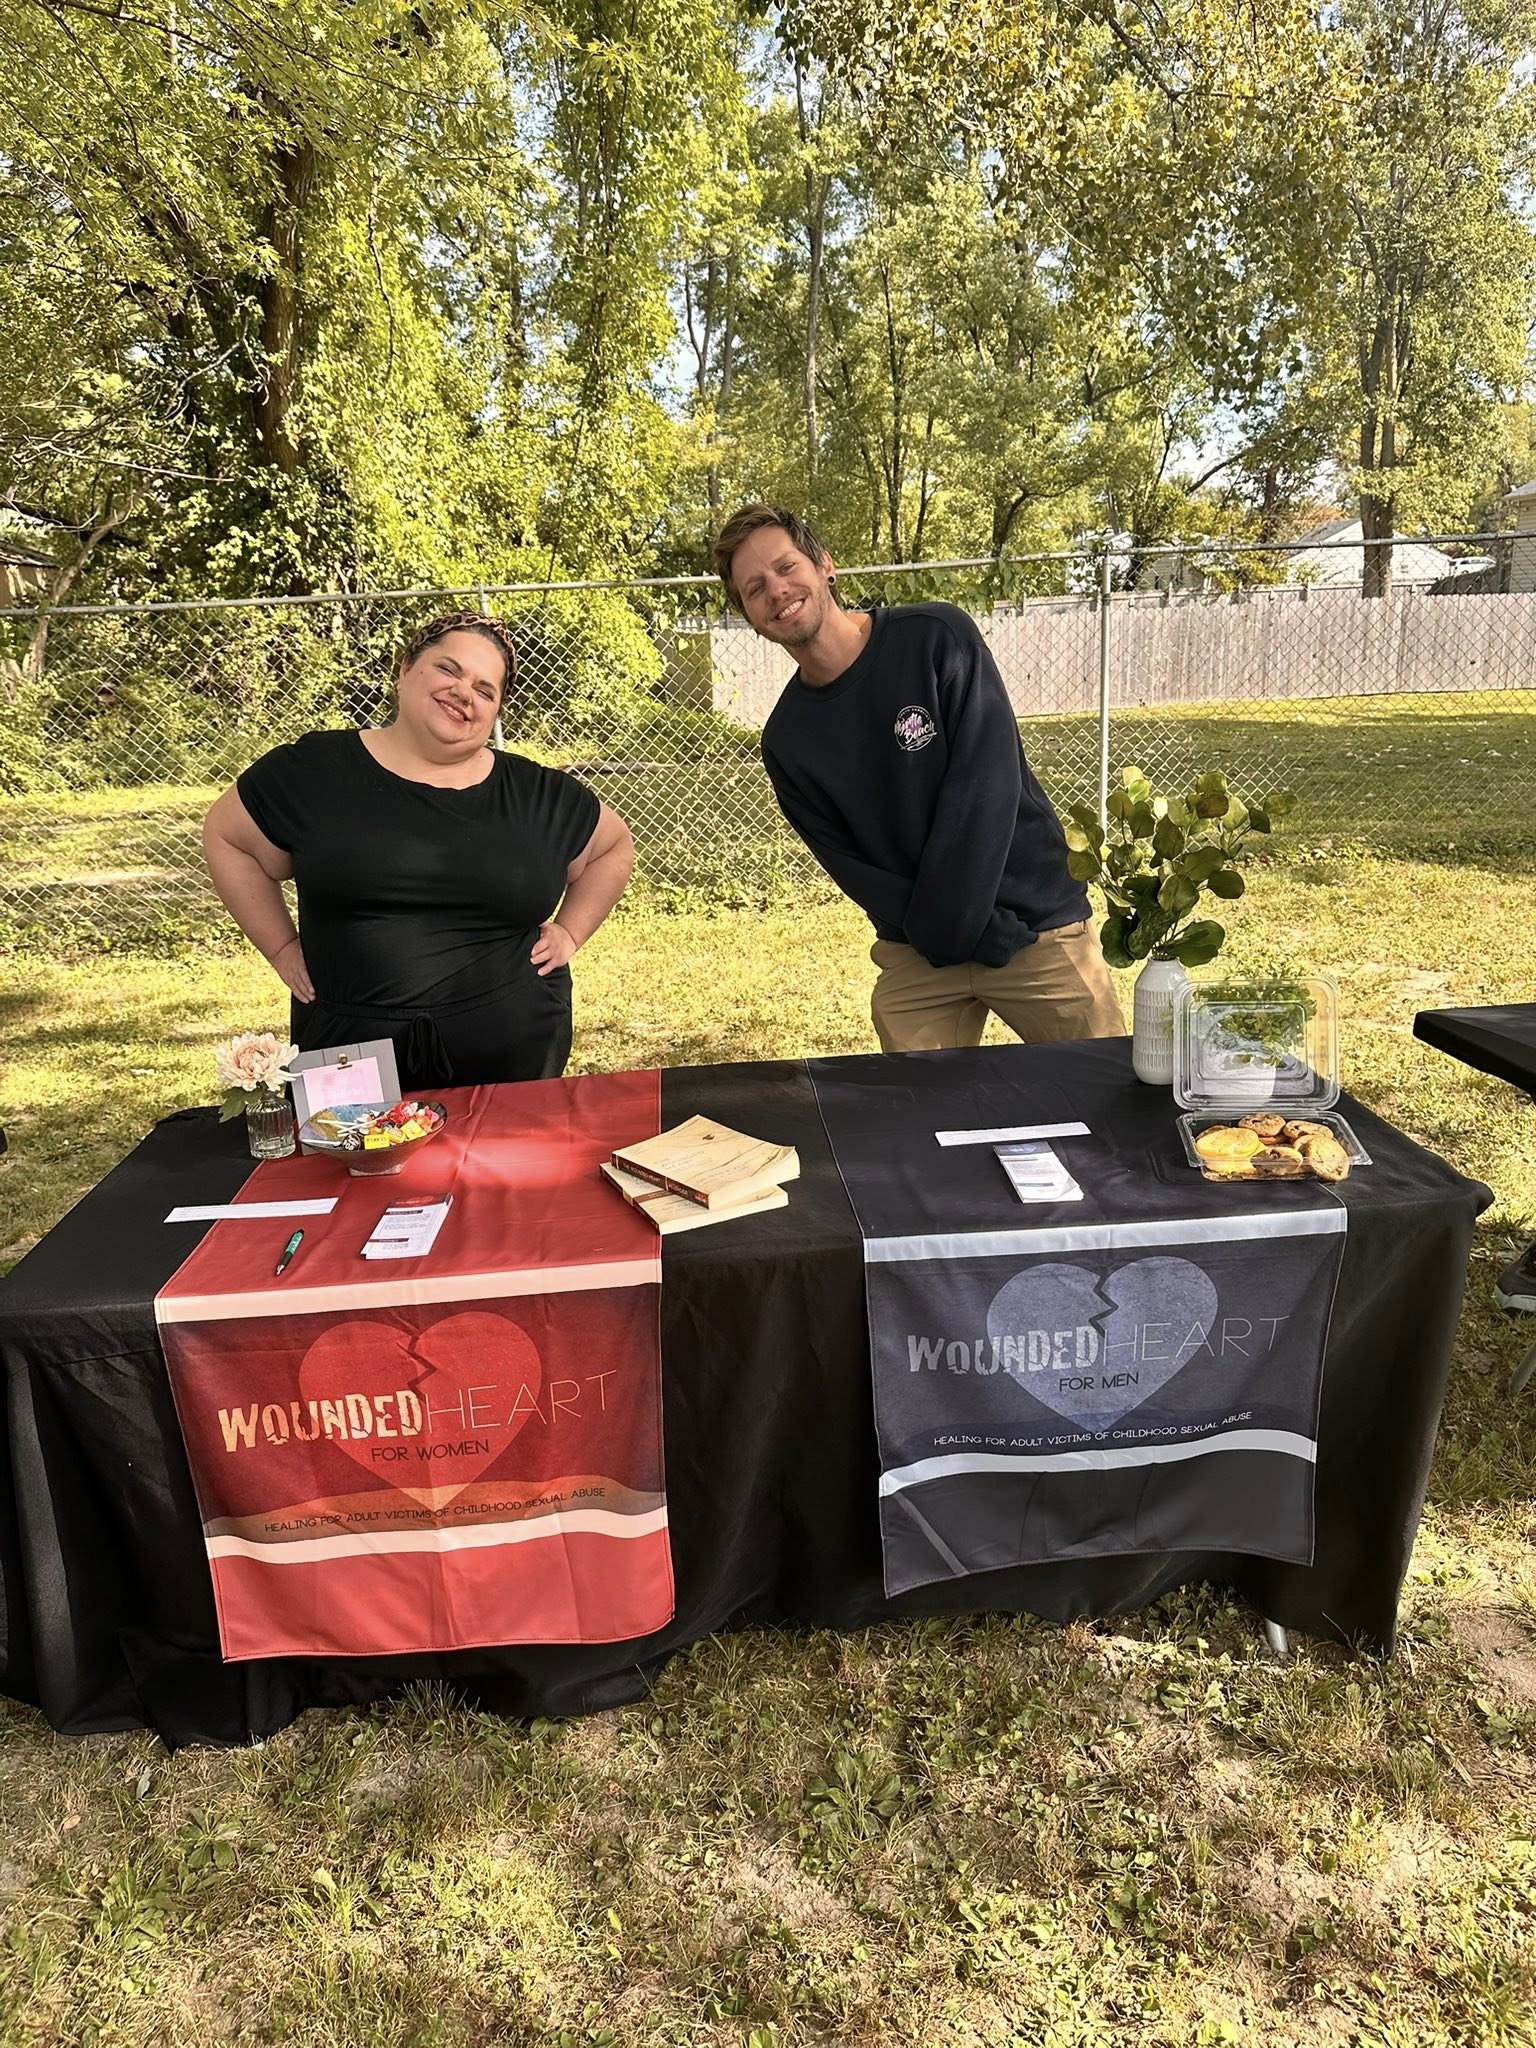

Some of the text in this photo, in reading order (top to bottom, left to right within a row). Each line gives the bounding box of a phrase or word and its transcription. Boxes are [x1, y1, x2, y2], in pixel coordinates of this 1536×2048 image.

[904, 719, 936, 745] Beach
[907, 1314, 1291, 1377] WOUNDED HEART
[1057, 1371, 1140, 1392] FOR MEN
[217, 1368, 618, 1453] WOUNDED HEART
[933, 1411, 1253, 1447] HEALING FOR ADULT VICTIMS OF CHILDHOOD SEXUAL ABUSE
[370, 1438, 490, 1464] FOR WOMEN
[264, 1487, 606, 1533] HEALING FOR ADULT VICTIMS OF CHILDHOOD SEXUAL ABUSE
